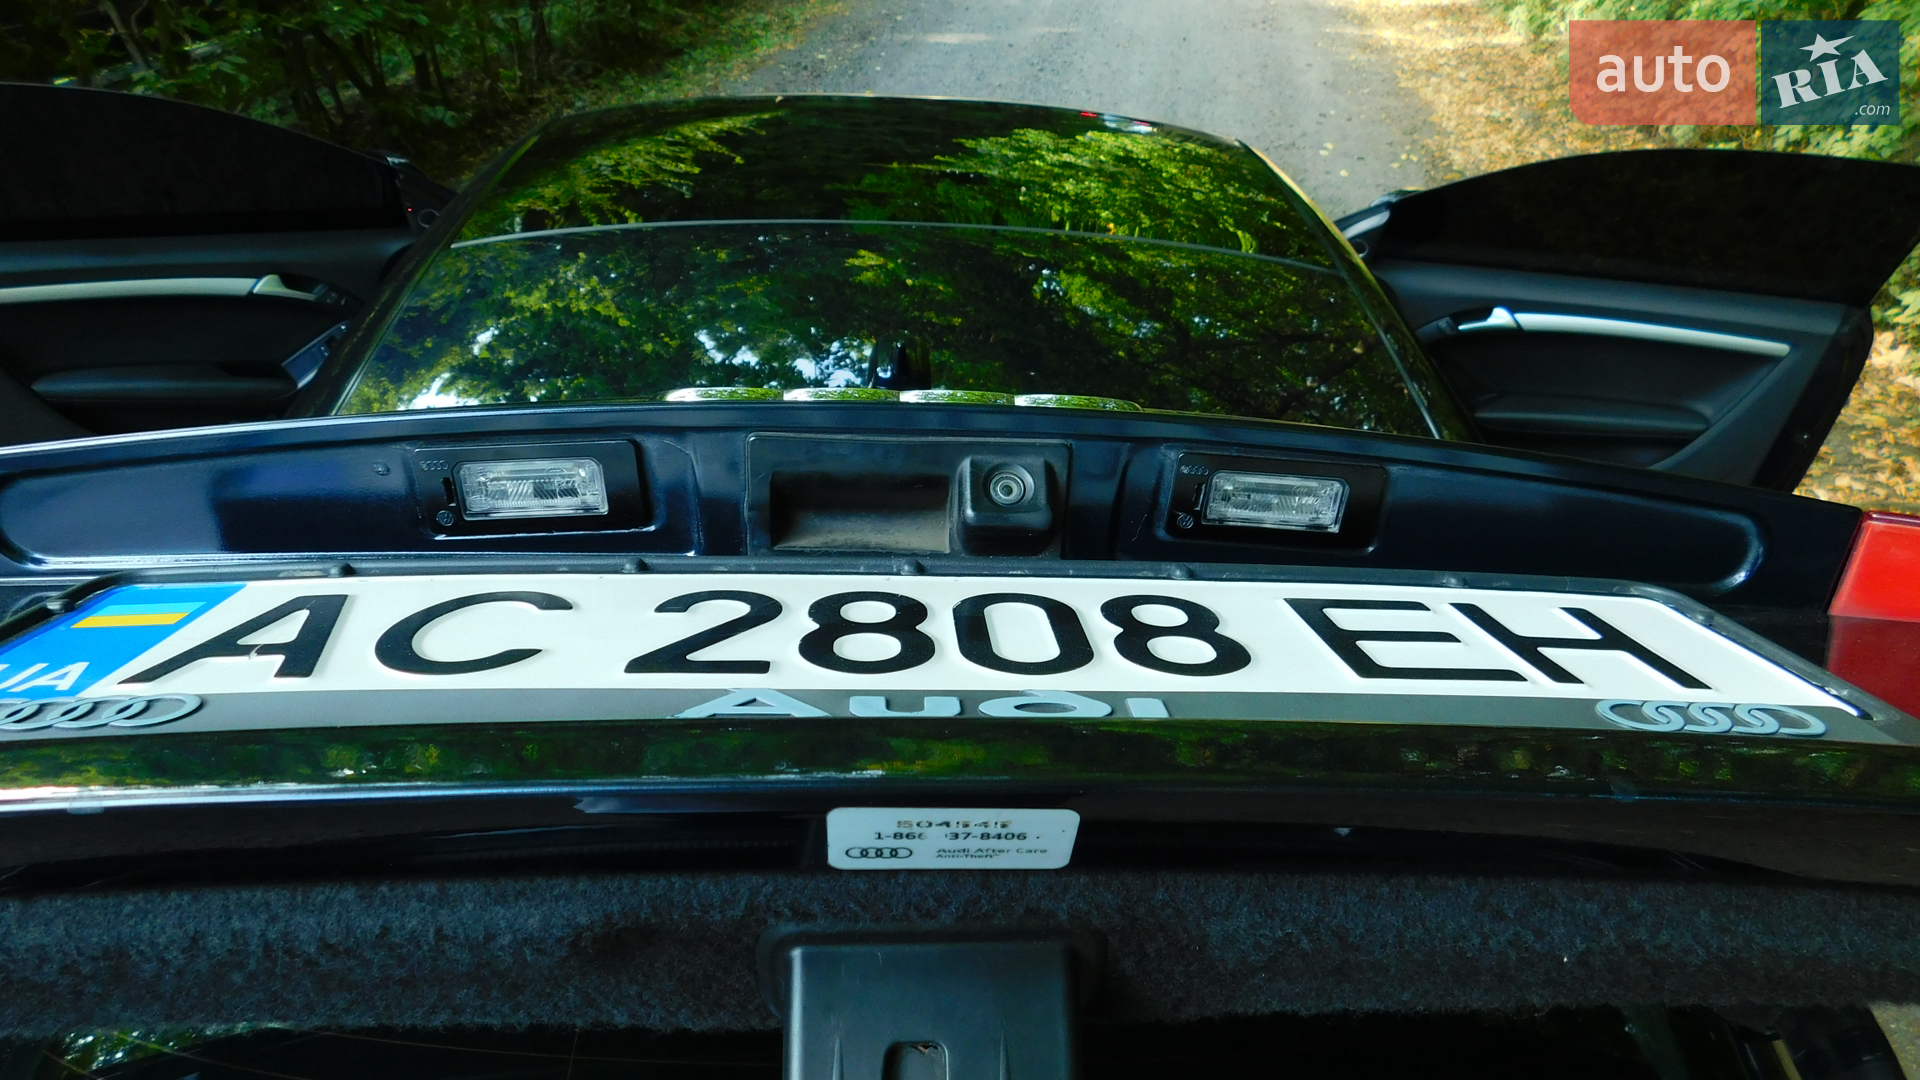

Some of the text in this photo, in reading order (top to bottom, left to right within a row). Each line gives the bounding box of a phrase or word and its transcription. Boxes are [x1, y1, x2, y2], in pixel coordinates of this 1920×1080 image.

[116, 589, 1714, 691] AC 2808 EH
